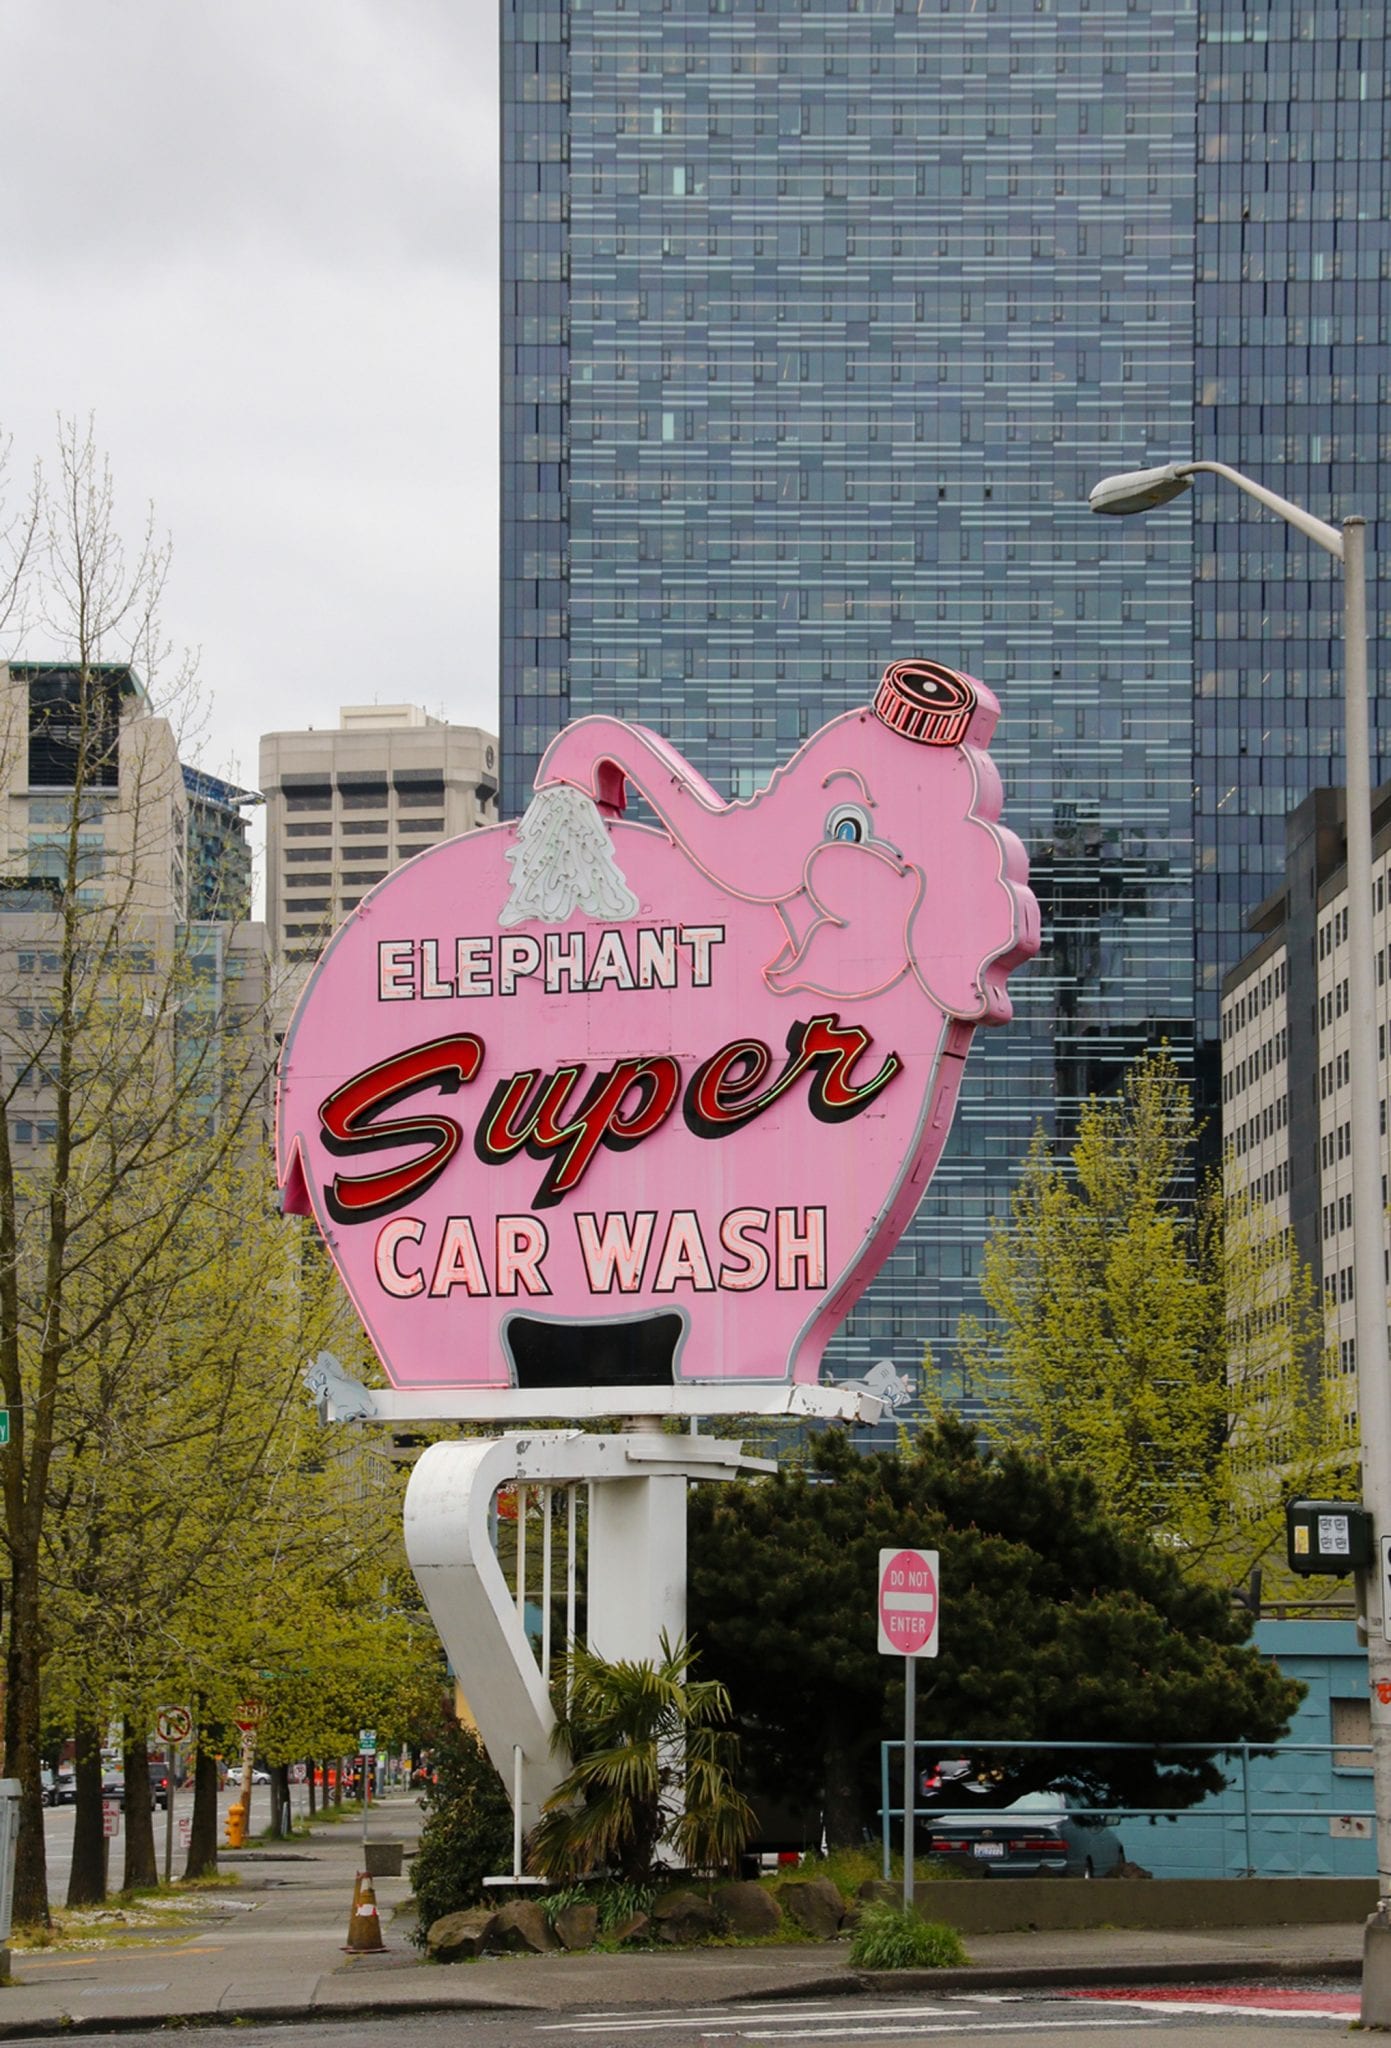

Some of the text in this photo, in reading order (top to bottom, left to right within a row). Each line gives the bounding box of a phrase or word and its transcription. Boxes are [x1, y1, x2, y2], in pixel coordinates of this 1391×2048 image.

[377, 925, 725, 1002] ELEPHANT
[318, 1013, 903, 1225] Super
[374, 1206, 829, 1299] CAR WASH
[890, 1570, 929, 1588] DO NOT
[890, 1616, 927, 1633] ENTER
